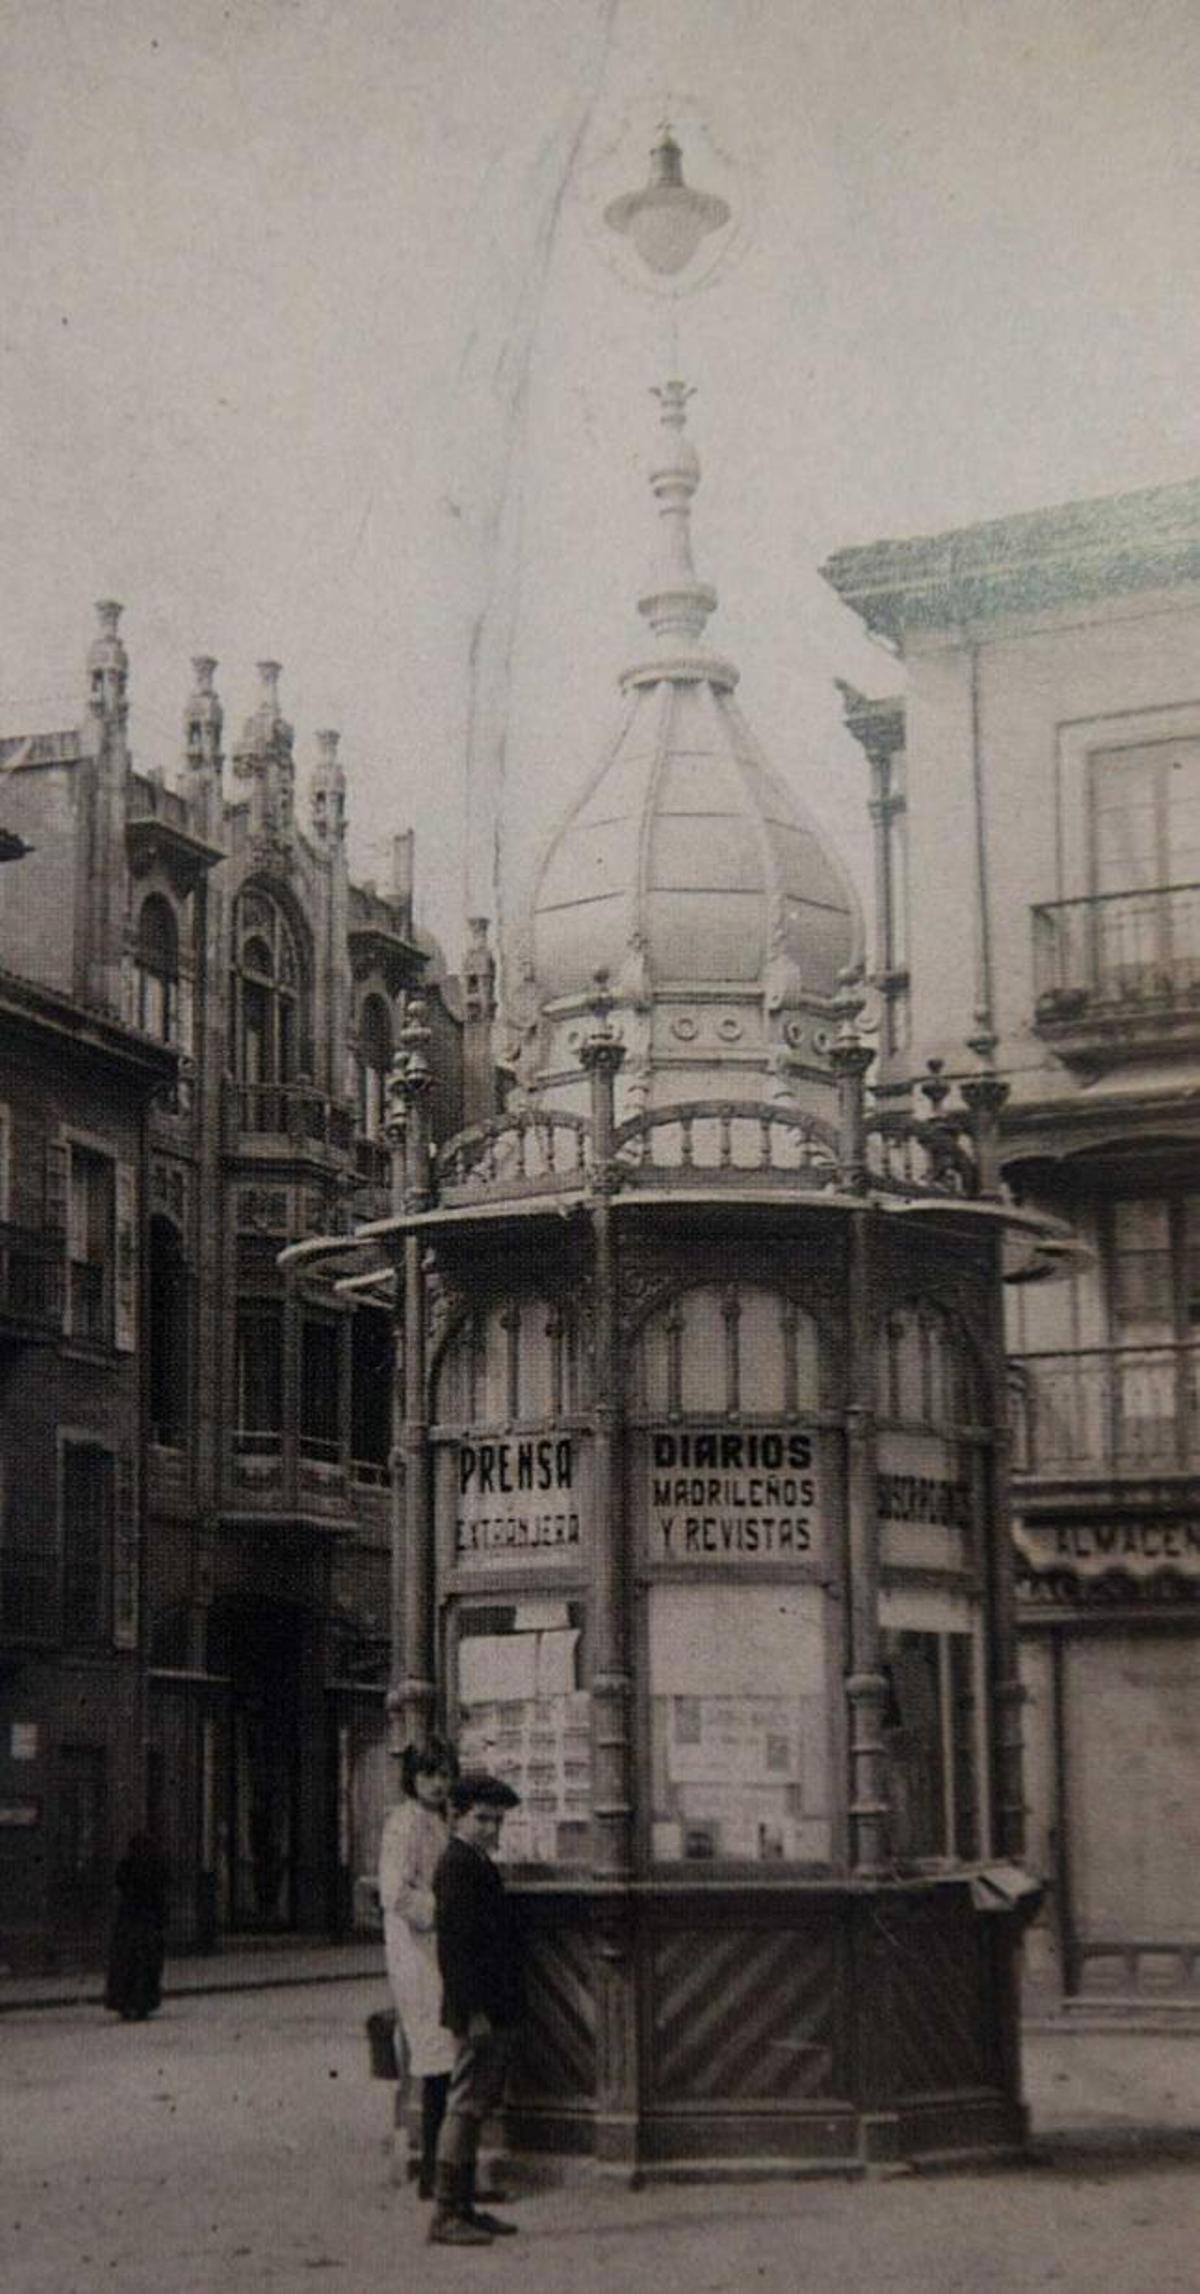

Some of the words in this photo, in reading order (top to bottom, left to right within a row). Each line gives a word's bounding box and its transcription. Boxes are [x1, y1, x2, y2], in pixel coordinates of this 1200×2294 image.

[461, 1439, 572, 1495] PRENSA
[652, 1433, 812, 1469] DIARIOS
[652, 1474, 815, 1507] MADRILEÑOS
[455, 1513, 580, 1551] EXTRANJERA
[661, 1518, 673, 1548] Y
[686, 1518, 811, 1551] REVISTAS
